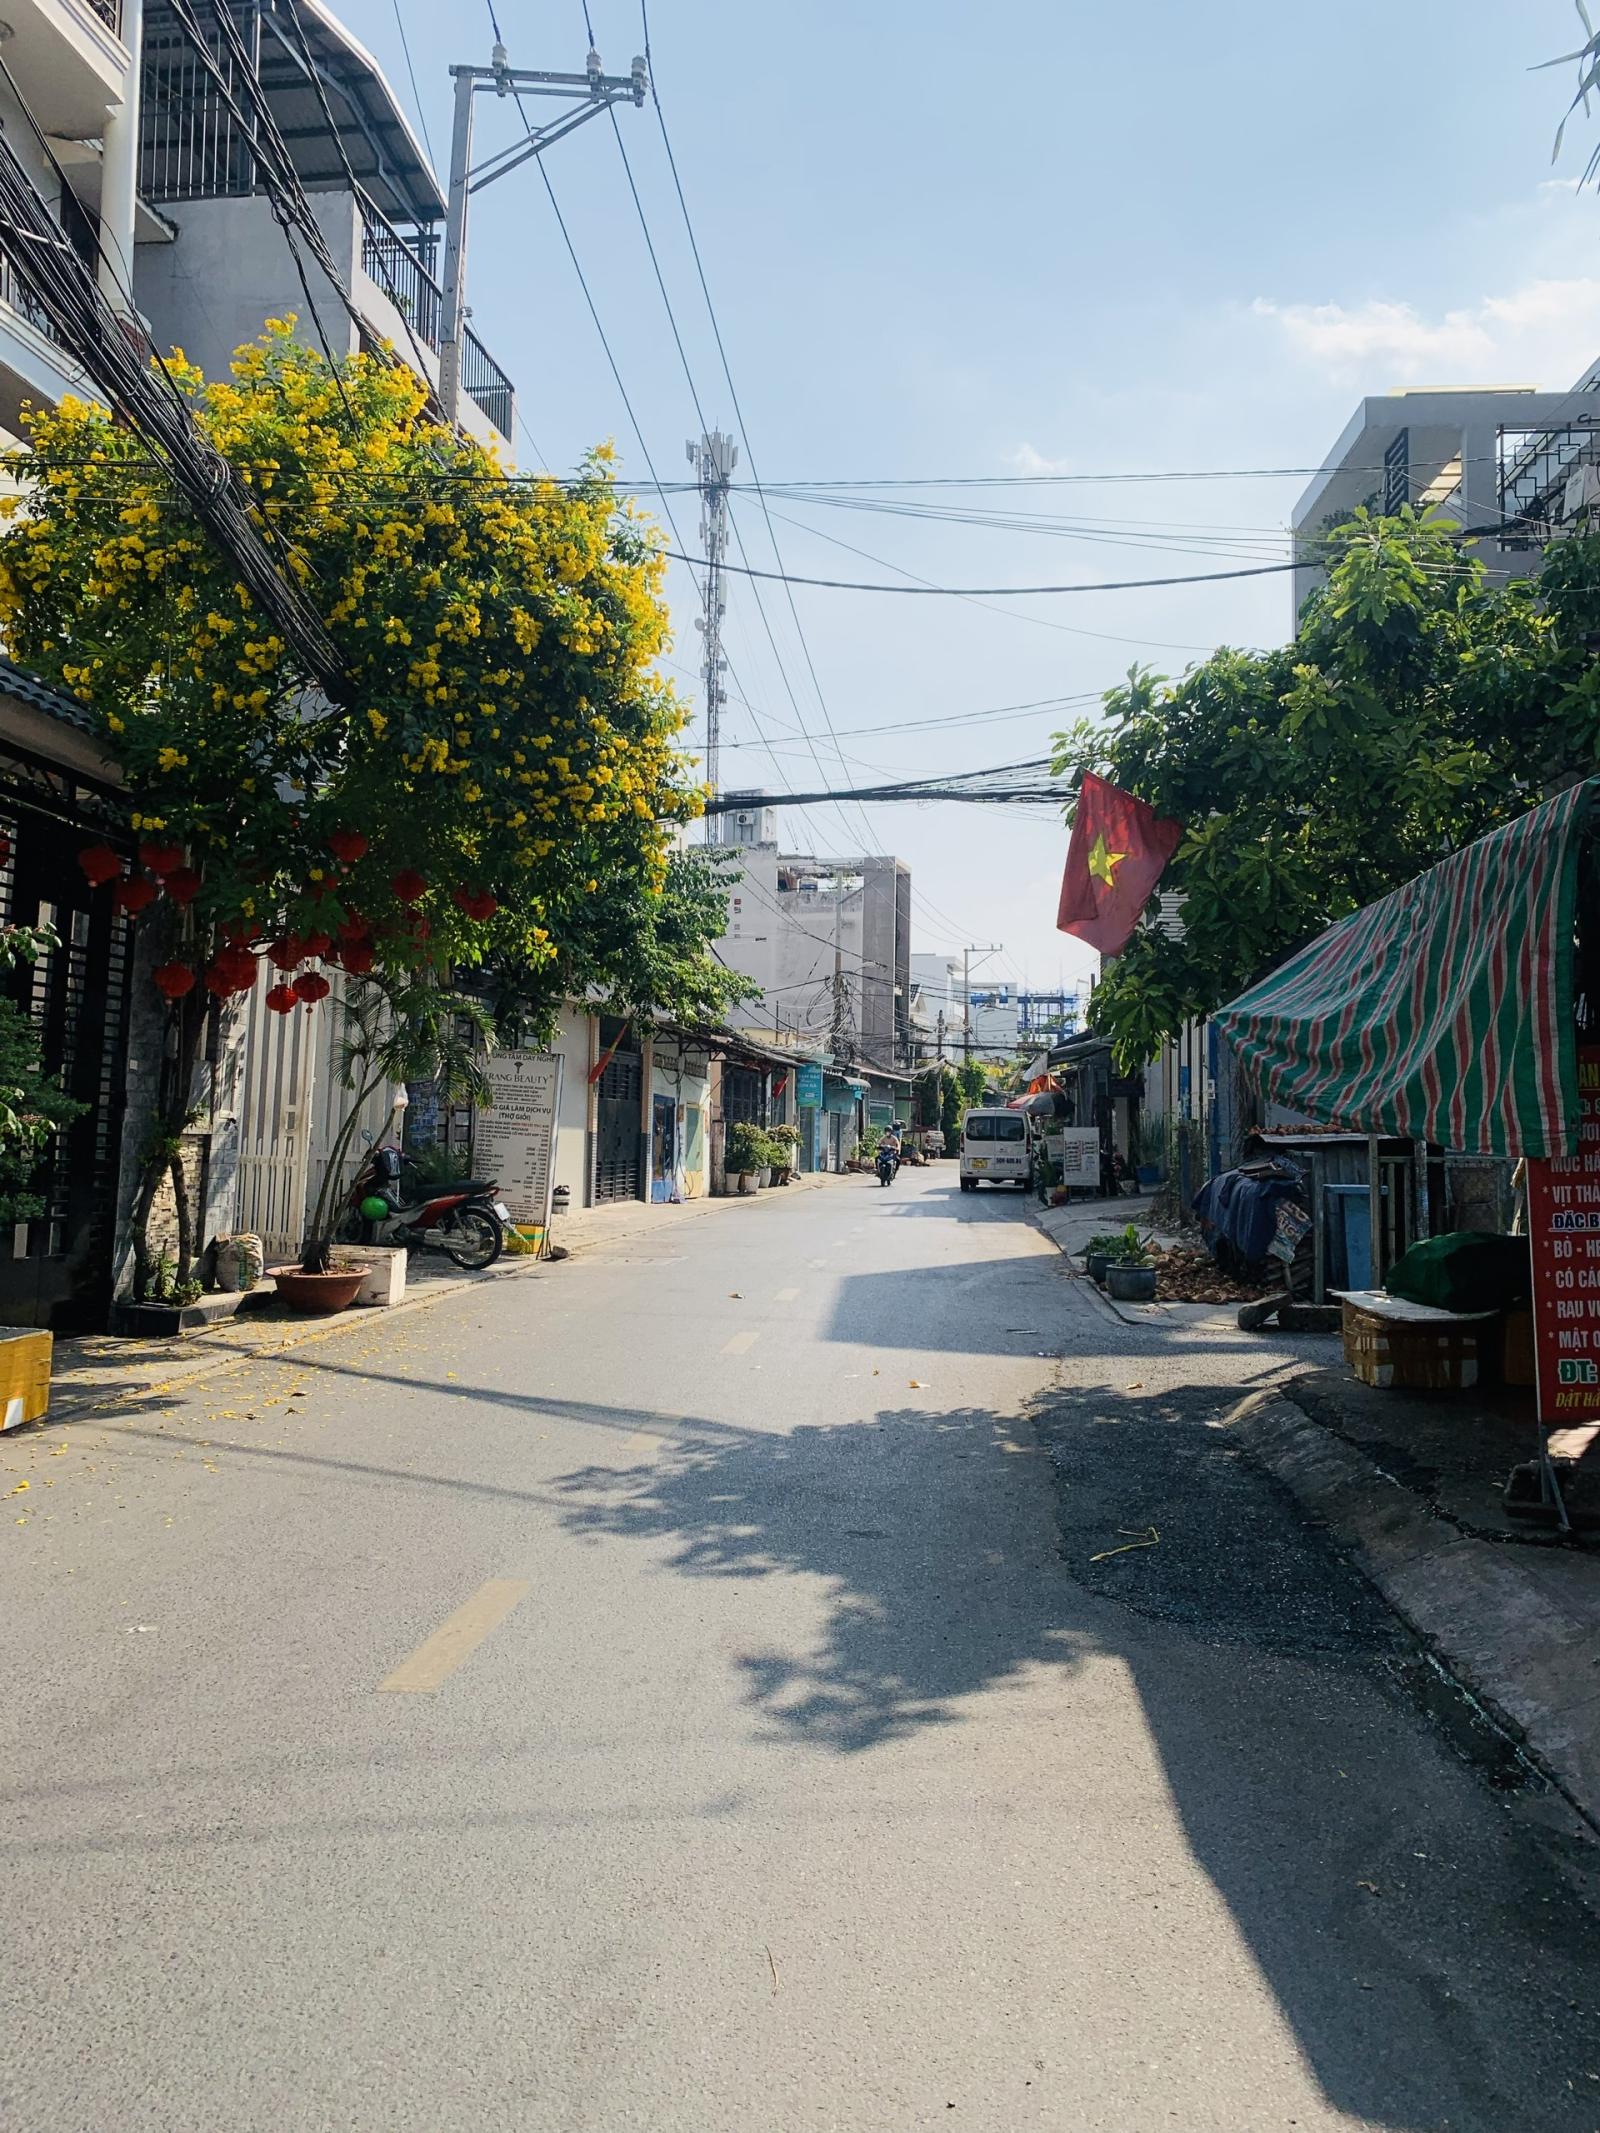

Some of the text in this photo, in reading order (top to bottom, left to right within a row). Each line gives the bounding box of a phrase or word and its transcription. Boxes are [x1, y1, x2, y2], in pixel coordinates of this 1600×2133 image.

[514, 1075, 549, 1085] BEAUTY
[1552, 1185, 1572, 1207] VỊT
[1555, 1266, 1574, 1289] CÓ
[1557, 1300, 1584, 1319] RAU
[1559, 1327, 1588, 1353] MẬT
[1557, 1358, 1598, 1384] ĐT:
